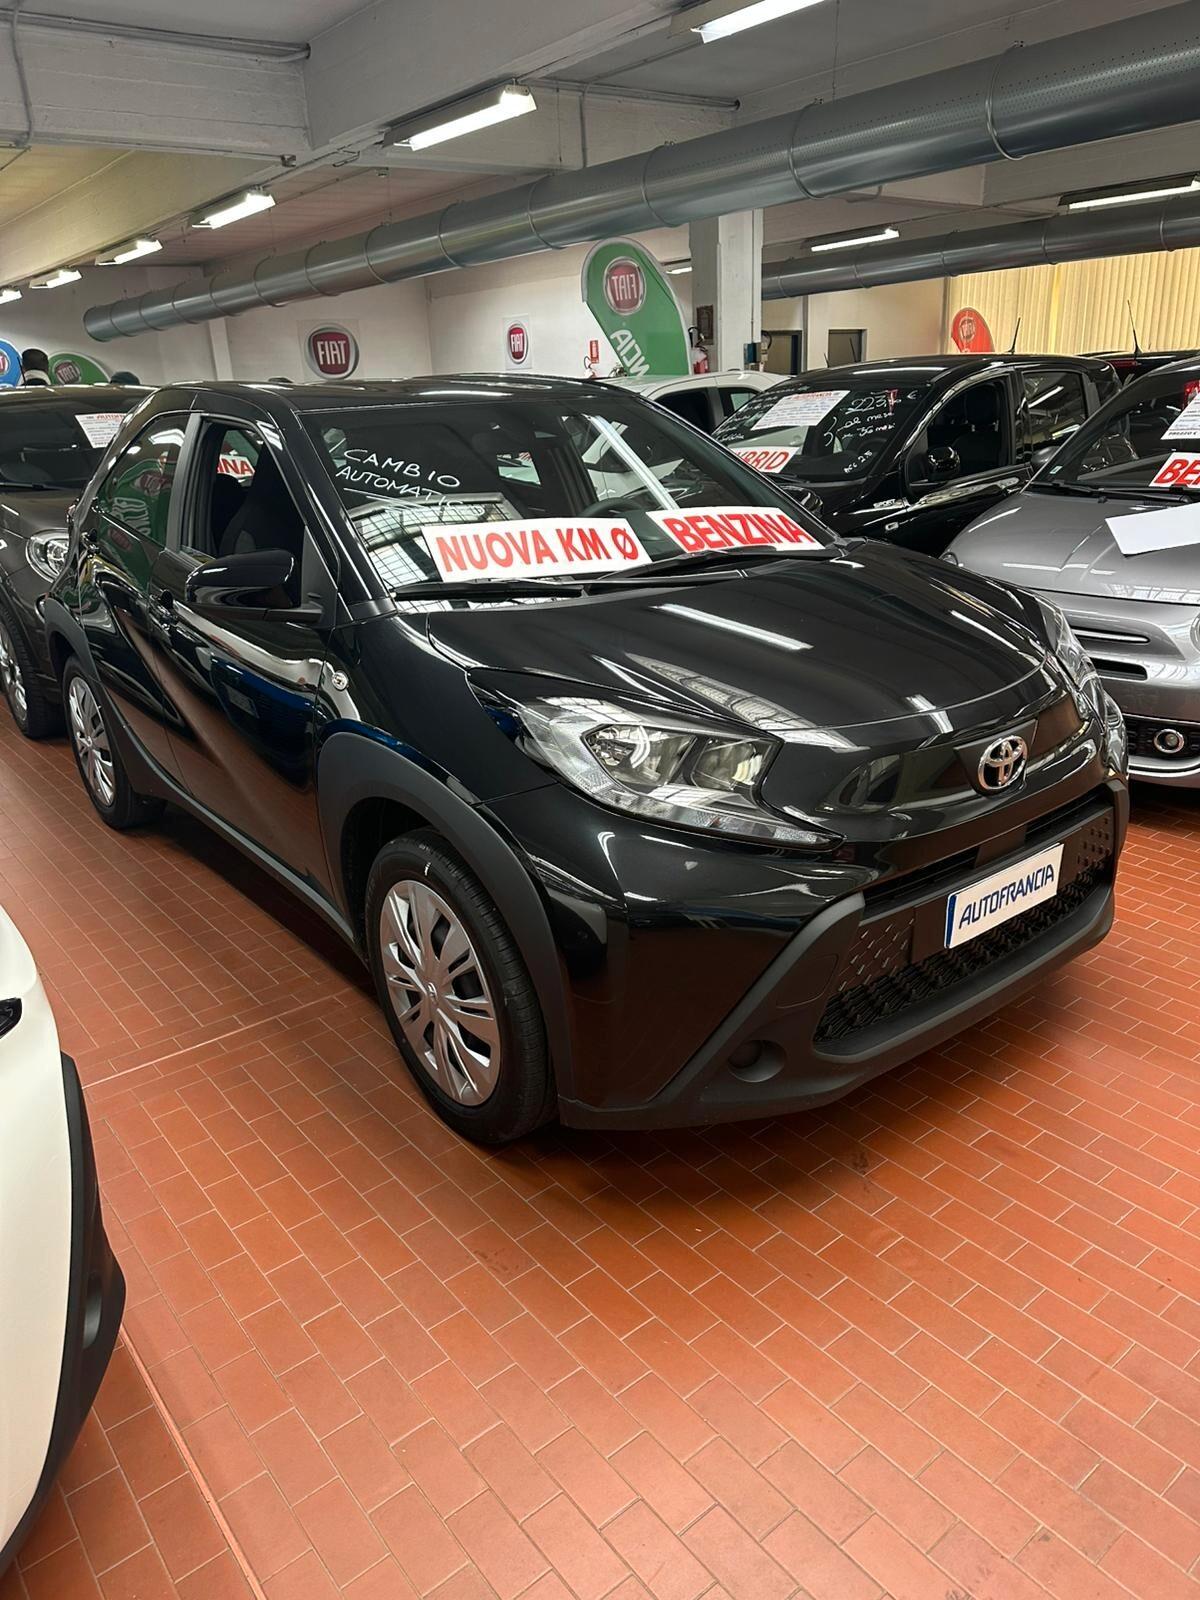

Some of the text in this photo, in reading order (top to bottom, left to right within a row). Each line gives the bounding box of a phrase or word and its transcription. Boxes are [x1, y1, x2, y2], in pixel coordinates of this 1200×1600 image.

[317, 341, 346, 365] FIAT
[510, 333, 524, 352] FIAT
[343, 449, 460, 487] CAMBIO
[1154, 459, 1200, 484] BE
[436, 530, 558, 572] NUOVA
[555, 528, 612, 561] KM
[662, 513, 815, 553] BENZINA
[959, 864, 1054, 929] AUTOFRANCIA
